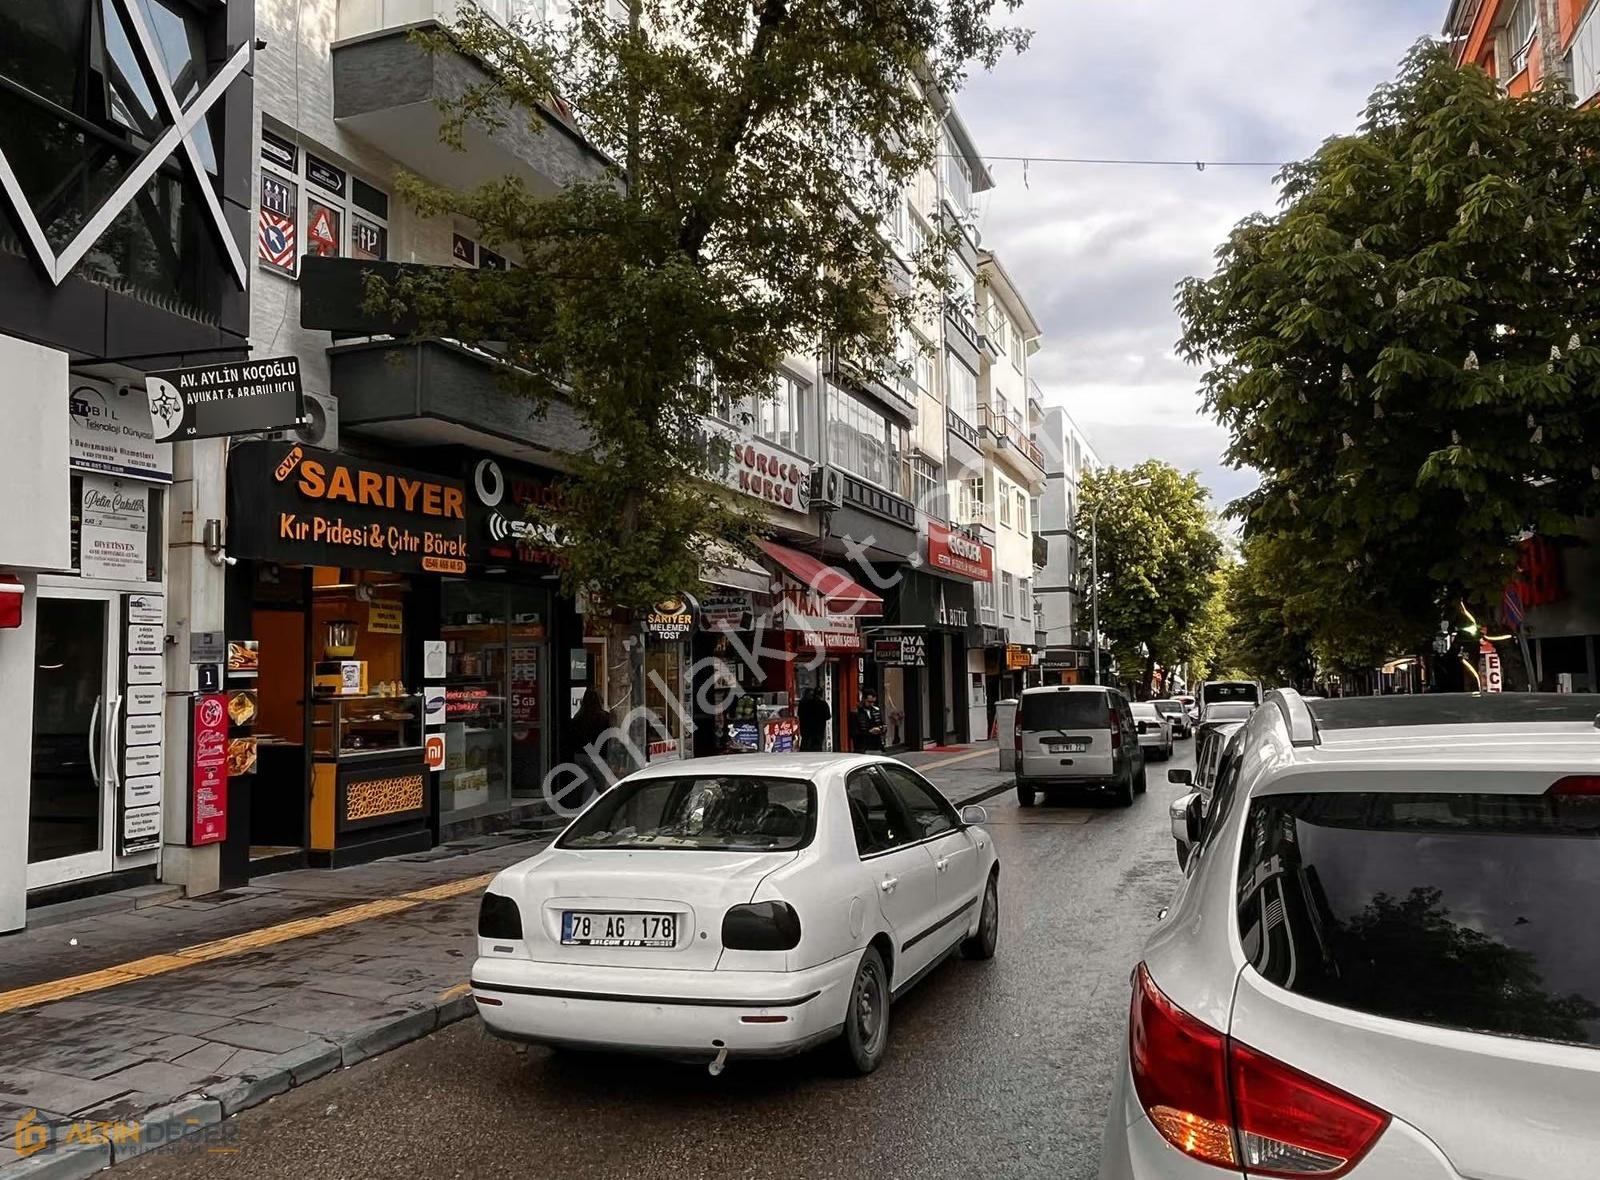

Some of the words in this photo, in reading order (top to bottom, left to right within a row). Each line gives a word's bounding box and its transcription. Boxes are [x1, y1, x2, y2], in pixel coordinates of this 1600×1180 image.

[181, 374, 198, 387] AV.
[201, 366, 239, 385] AYLİN
[243, 361, 296, 381] KOÇOĞLU
[187, 389, 224, 405] AVUKAT
[734, 443, 799, 486] SÜRÜCÜ
[299, 460, 464, 519] SARIYER
[738, 469, 793, 506] KURSU
[280, 512, 310, 540] Kır
[313, 517, 368, 548] Pidesi
[369, 523, 386, 549] &
[387, 526, 421, 556] Çıtır
[424, 531, 467, 557] Börek
[647, 613, 692, 624] SARIYER
[649, 623, 690, 633] MELEMEN
[659, 631, 681, 640] TOST
[205, 671, 212, 685] 1
[1487, 656, 1500, 692] EC
[572, 917, 592, 937] 78
[606, 917, 625, 938] AG
[642, 917, 672, 938] 178
